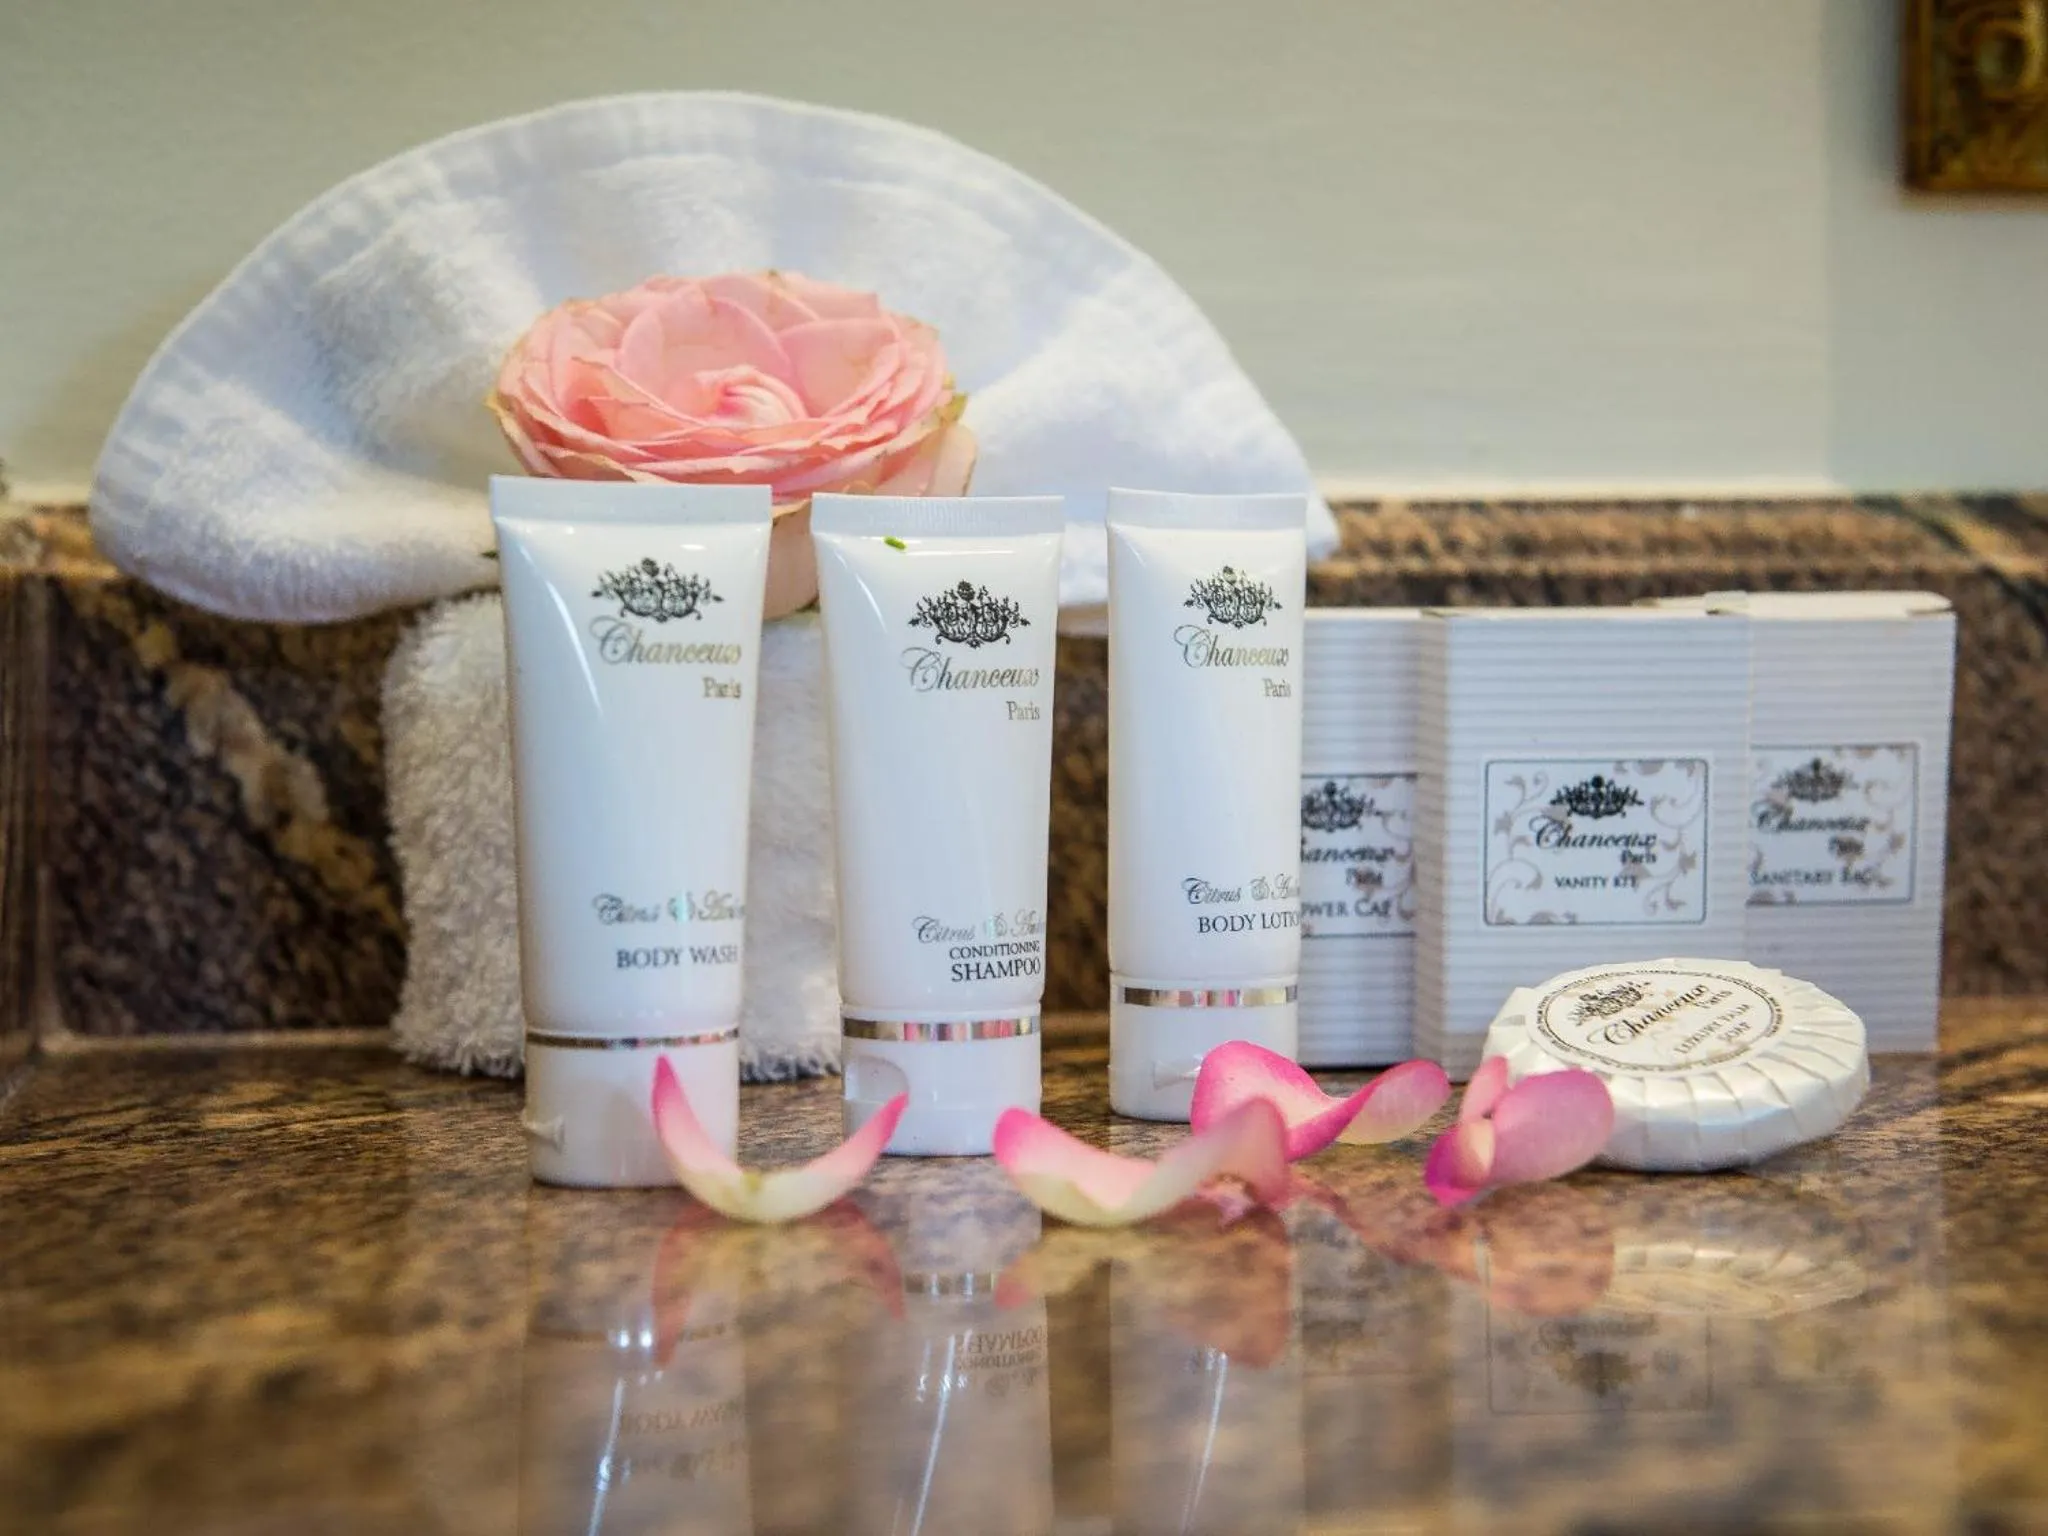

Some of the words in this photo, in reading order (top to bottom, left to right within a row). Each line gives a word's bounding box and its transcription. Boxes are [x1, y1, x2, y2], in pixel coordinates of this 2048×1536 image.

[589, 614, 742, 666] Chanceux
[1173, 624, 1290, 669] Chanceux
[900, 646, 1041, 693] Chanceux
[703, 677, 742, 698] Paris
[1262, 677, 1292, 698] Paris
[1005, 700, 1041, 721] Paris
[1529, 814, 1657, 850] Chanceux
[1620, 850, 1657, 865] Paris
[1181, 877, 1243, 905] Citrus
[1554, 875, 1608, 889] VANITY
[911, 915, 976, 944] Citrus
[1197, 913, 1257, 934] BODY
[1261, 911, 1300, 930] LOTIO
[616, 948, 682, 969] BODY
[688, 945, 740, 966] WASH
[951, 956, 1042, 982] SHAMPOO
